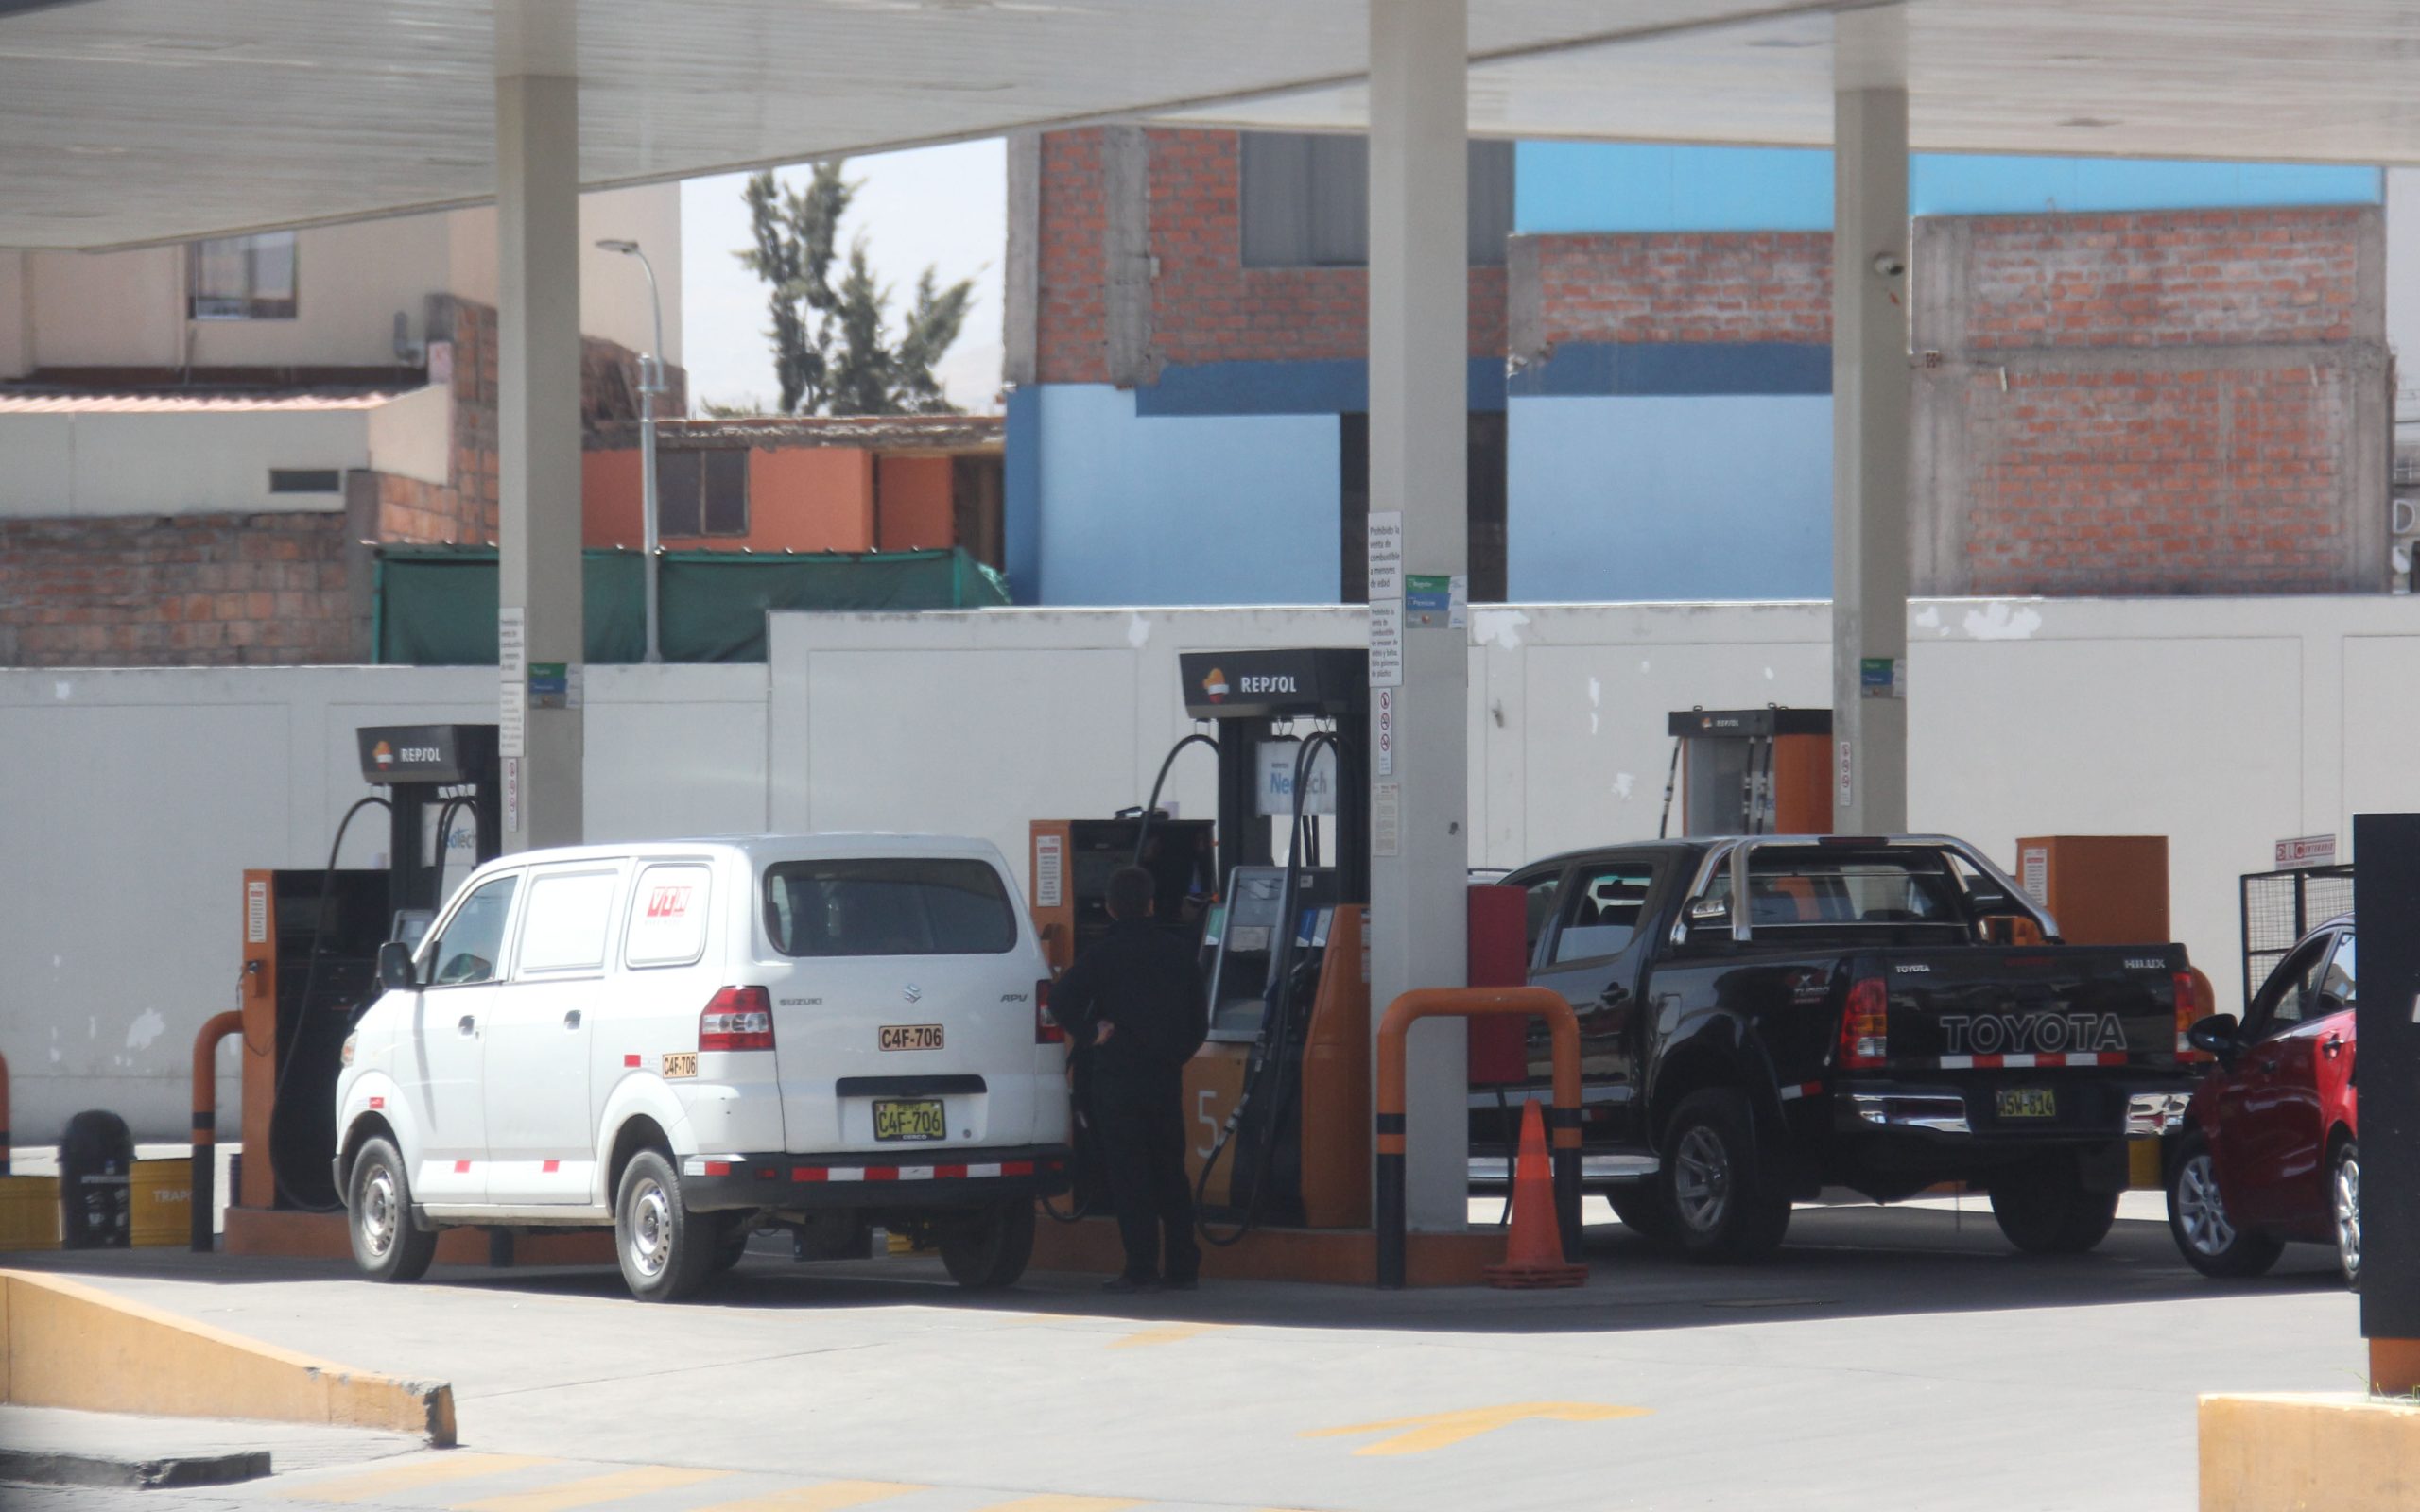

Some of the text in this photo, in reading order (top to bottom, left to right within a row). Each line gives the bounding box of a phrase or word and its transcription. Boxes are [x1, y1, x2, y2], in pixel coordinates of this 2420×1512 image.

[1240, 676, 1297, 693] REPSOL
[400, 747, 441, 763] REPSOL
[1895, 964, 1931, 973] TOYOTA
[2124, 958, 2166, 970] HILUX
[779, 997, 823, 1006] SUZUKI
[1000, 993, 1028, 1003] APV
[881, 1026, 942, 1049] C4F-706
[1940, 1013, 2128, 1055] TOYOTA
[664, 1055, 696, 1074] C4F-706
[878, 1111, 941, 1133] C4F-706
[1197, 1091, 1219, 1159] 5
